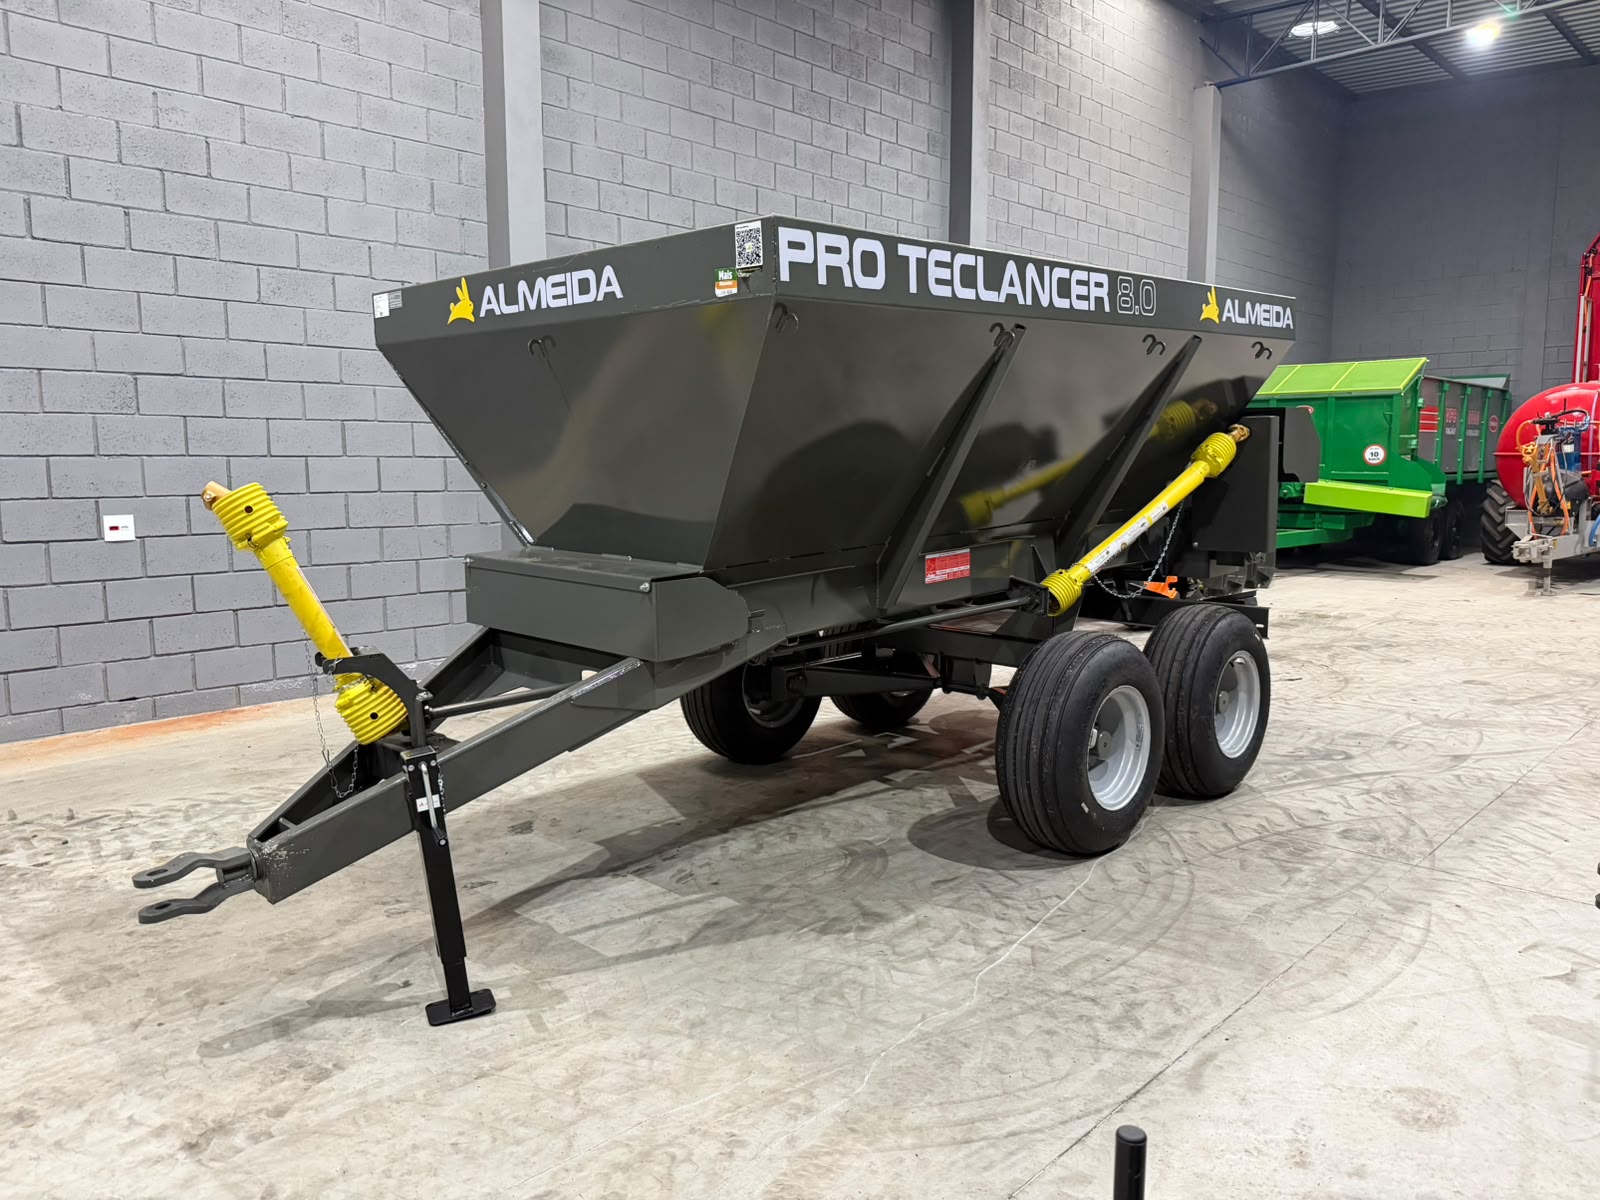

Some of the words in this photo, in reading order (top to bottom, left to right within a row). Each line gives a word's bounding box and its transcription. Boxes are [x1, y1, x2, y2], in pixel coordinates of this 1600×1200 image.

[479, 264, 624, 318] ALMEIDA
[777, 226, 886, 290] PRO
[897, 243, 1110, 313] TECLANCER
[1117, 275, 1157, 317] 8.0
[1221, 298, 1294, 330] ALMEIDA
